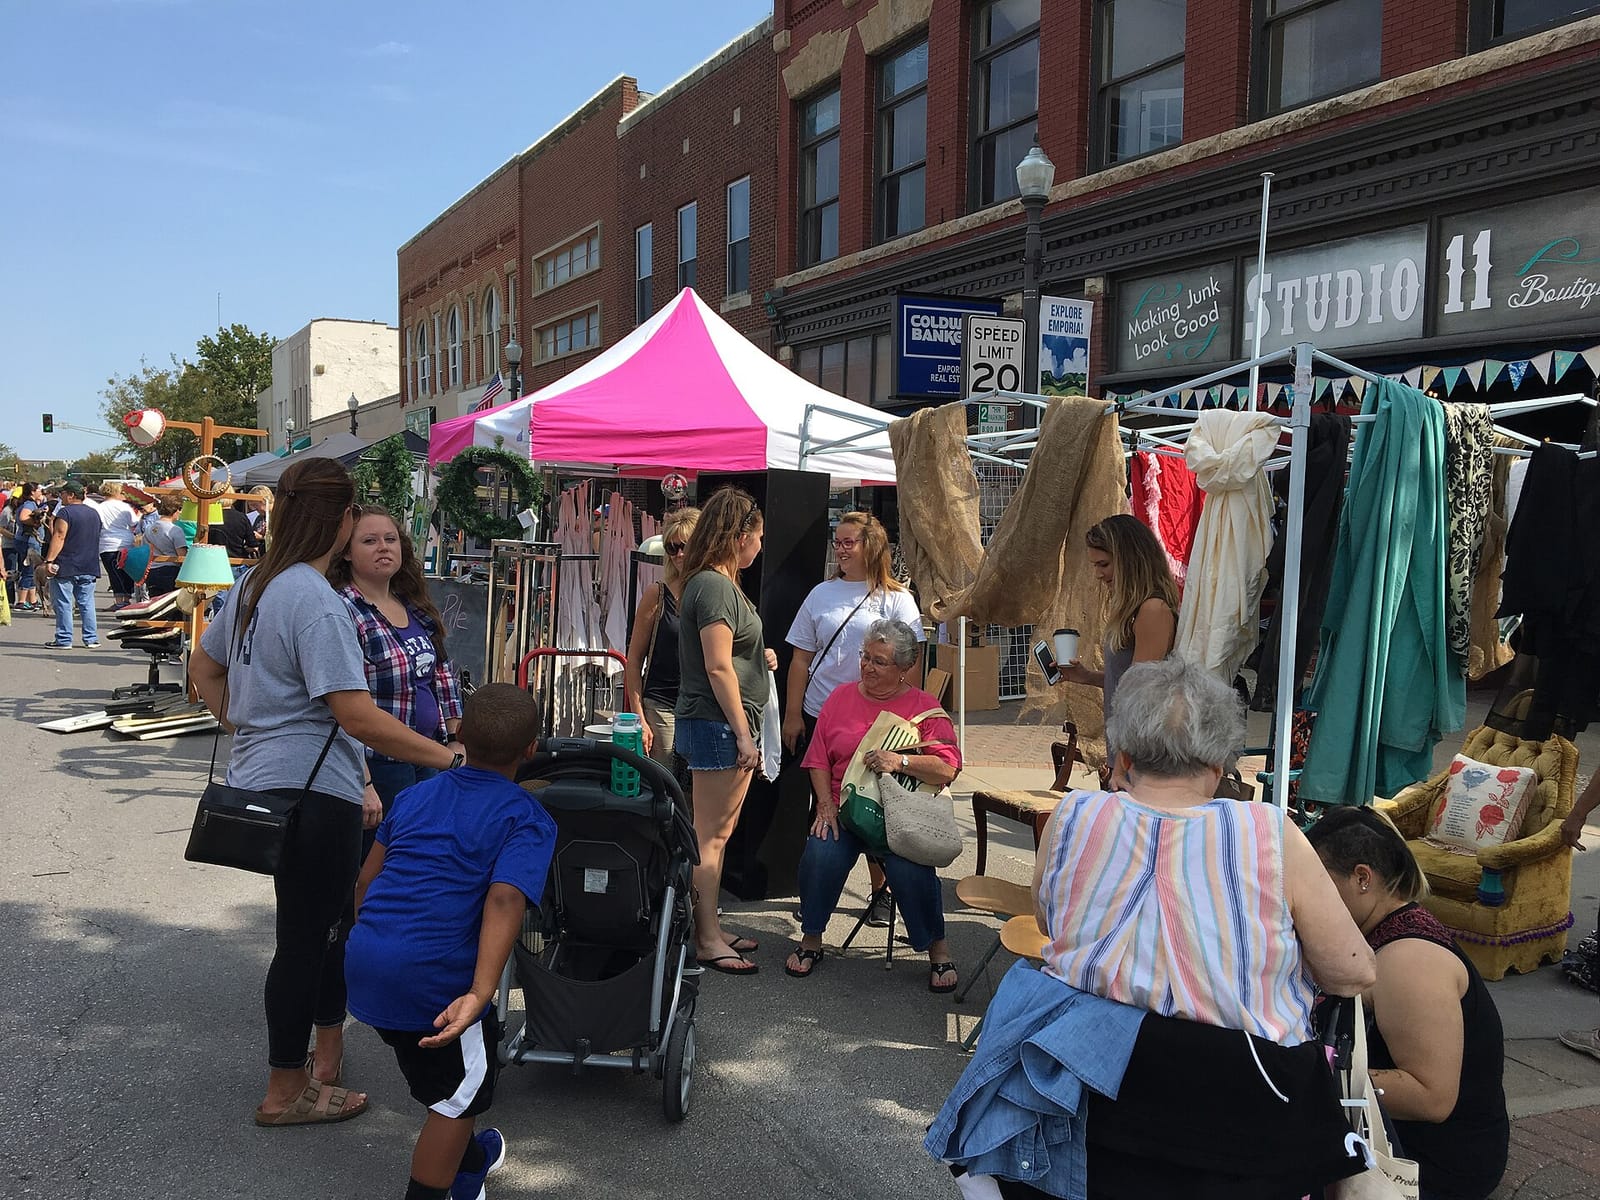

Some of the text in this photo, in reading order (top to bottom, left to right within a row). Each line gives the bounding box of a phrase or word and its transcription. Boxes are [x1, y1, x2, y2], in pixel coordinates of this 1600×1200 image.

[1245, 229, 1493, 341] STUDIO 11
[1050, 303, 1083, 320] EXPLORE
[1128, 276, 1221, 341] Making Junk
[974, 326, 1020, 343] SPEED
[1048, 319, 1084, 335] EMPORIA!
[1134, 300, 1220, 361] Look Good
[978, 345, 1014, 360] LIMIT
[930, 373, 948, 383] REAL
[972, 362, 1020, 392] 20
[981, 406, 988, 420] 2
